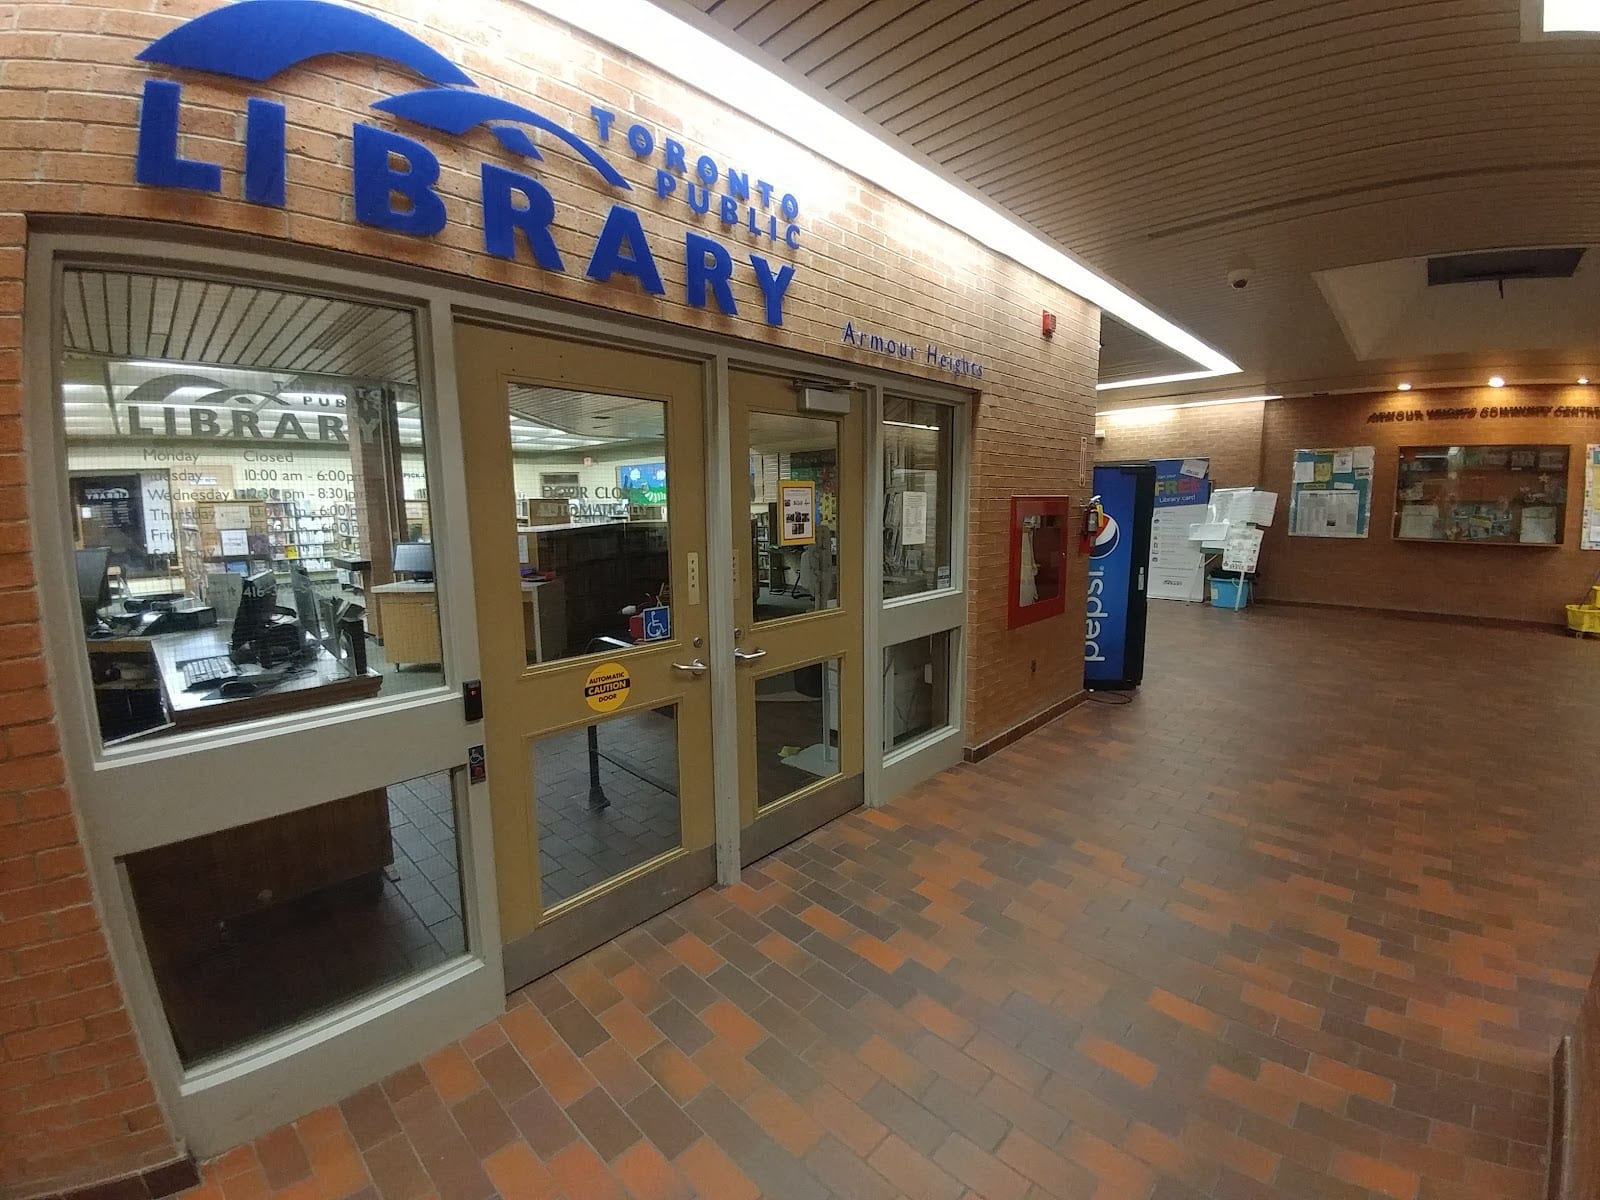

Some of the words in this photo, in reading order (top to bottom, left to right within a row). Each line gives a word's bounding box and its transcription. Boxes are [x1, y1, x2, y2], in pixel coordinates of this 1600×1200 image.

[591, 105, 799, 220] TORONTO
[136, 80, 795, 326] LIBRARY
[656, 168, 801, 250] PUBLIC
[843, 321, 917, 360] Armour
[927, 344, 983, 377] Heights
[128, 405, 382, 444] LIBRARY
[143, 448, 201, 464] Monday
[243, 450, 294, 463] Closed
[245, 469, 278, 481] 10:00
[148, 488, 230, 502] Wednesday
[318, 488, 343, 499] 8:30
[1084, 566, 1108, 662] pepsi
[588, 680, 627, 695] CAUTION
[589, 672, 625, 684] AUTOMATIC
[598, 693, 618, 702] DOOR
